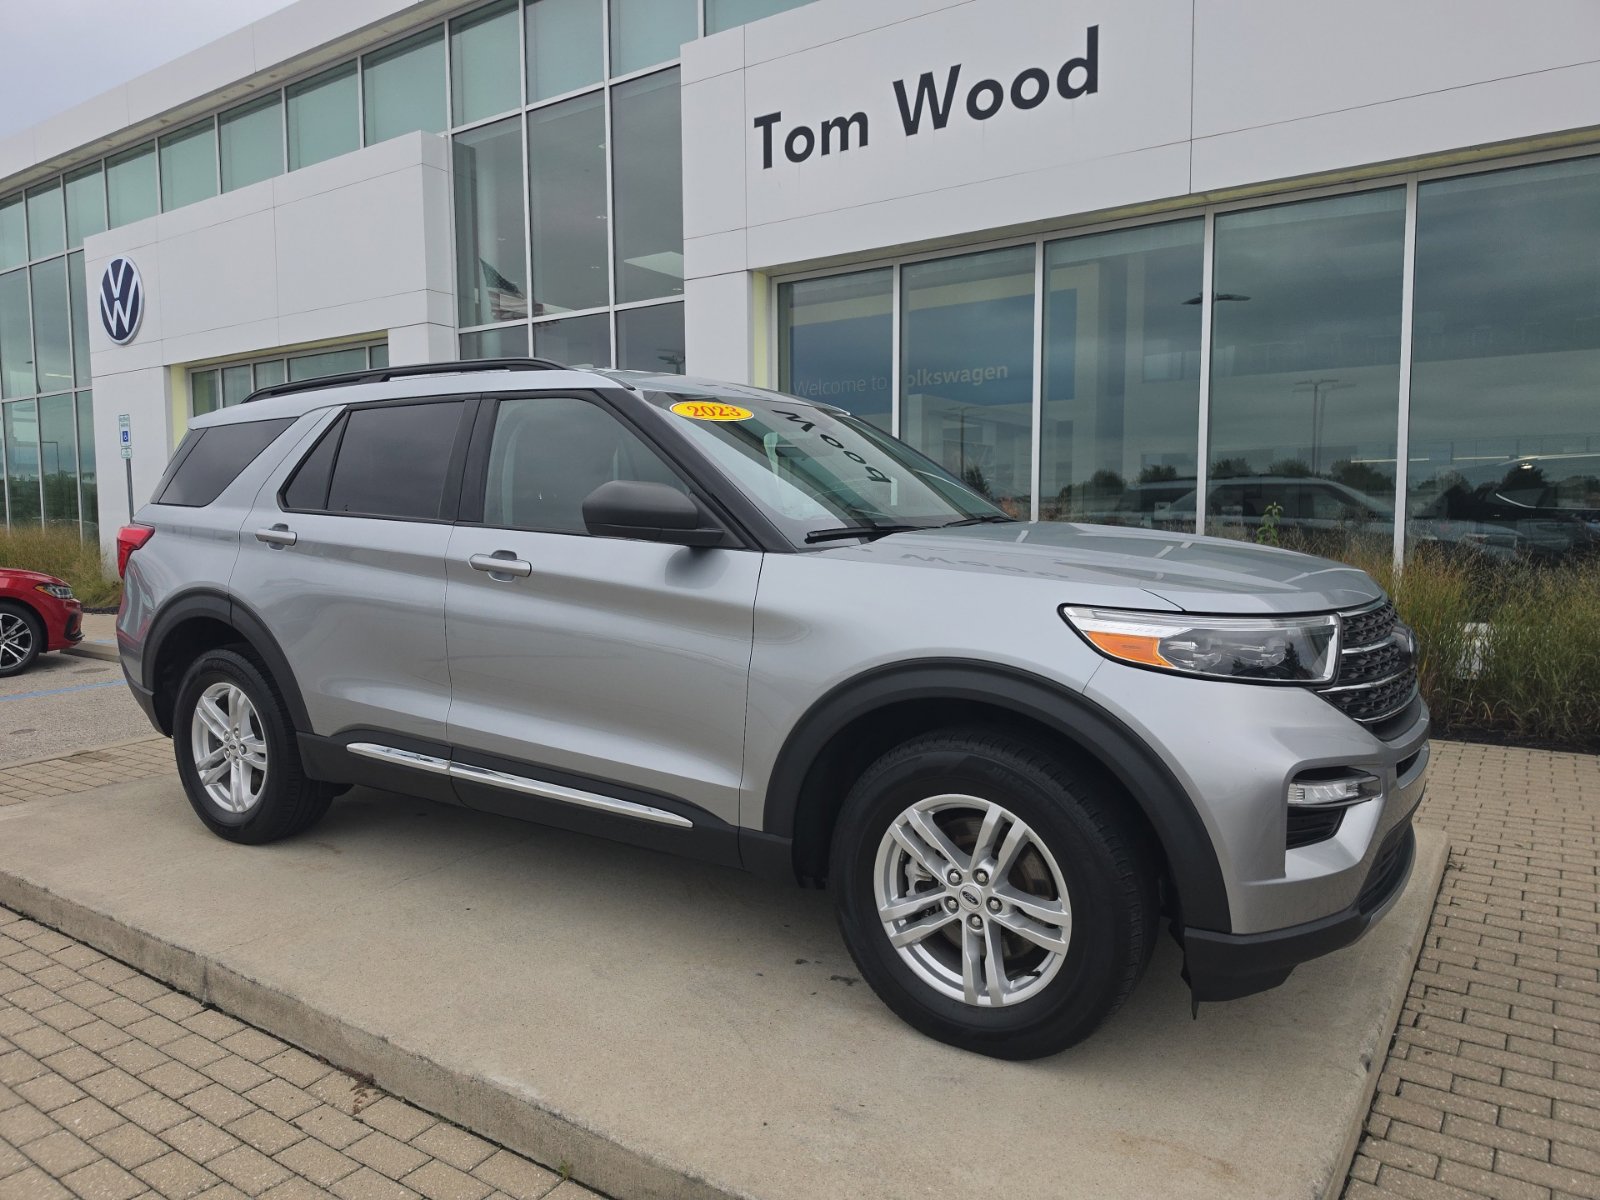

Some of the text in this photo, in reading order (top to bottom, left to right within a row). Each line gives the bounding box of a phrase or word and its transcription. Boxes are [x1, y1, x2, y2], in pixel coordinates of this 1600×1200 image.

[753, 24, 1099, 170] Tom Wood
[793, 365, 1009, 396] Welcome to olkswagen
[686, 405, 742, 417] 2023
